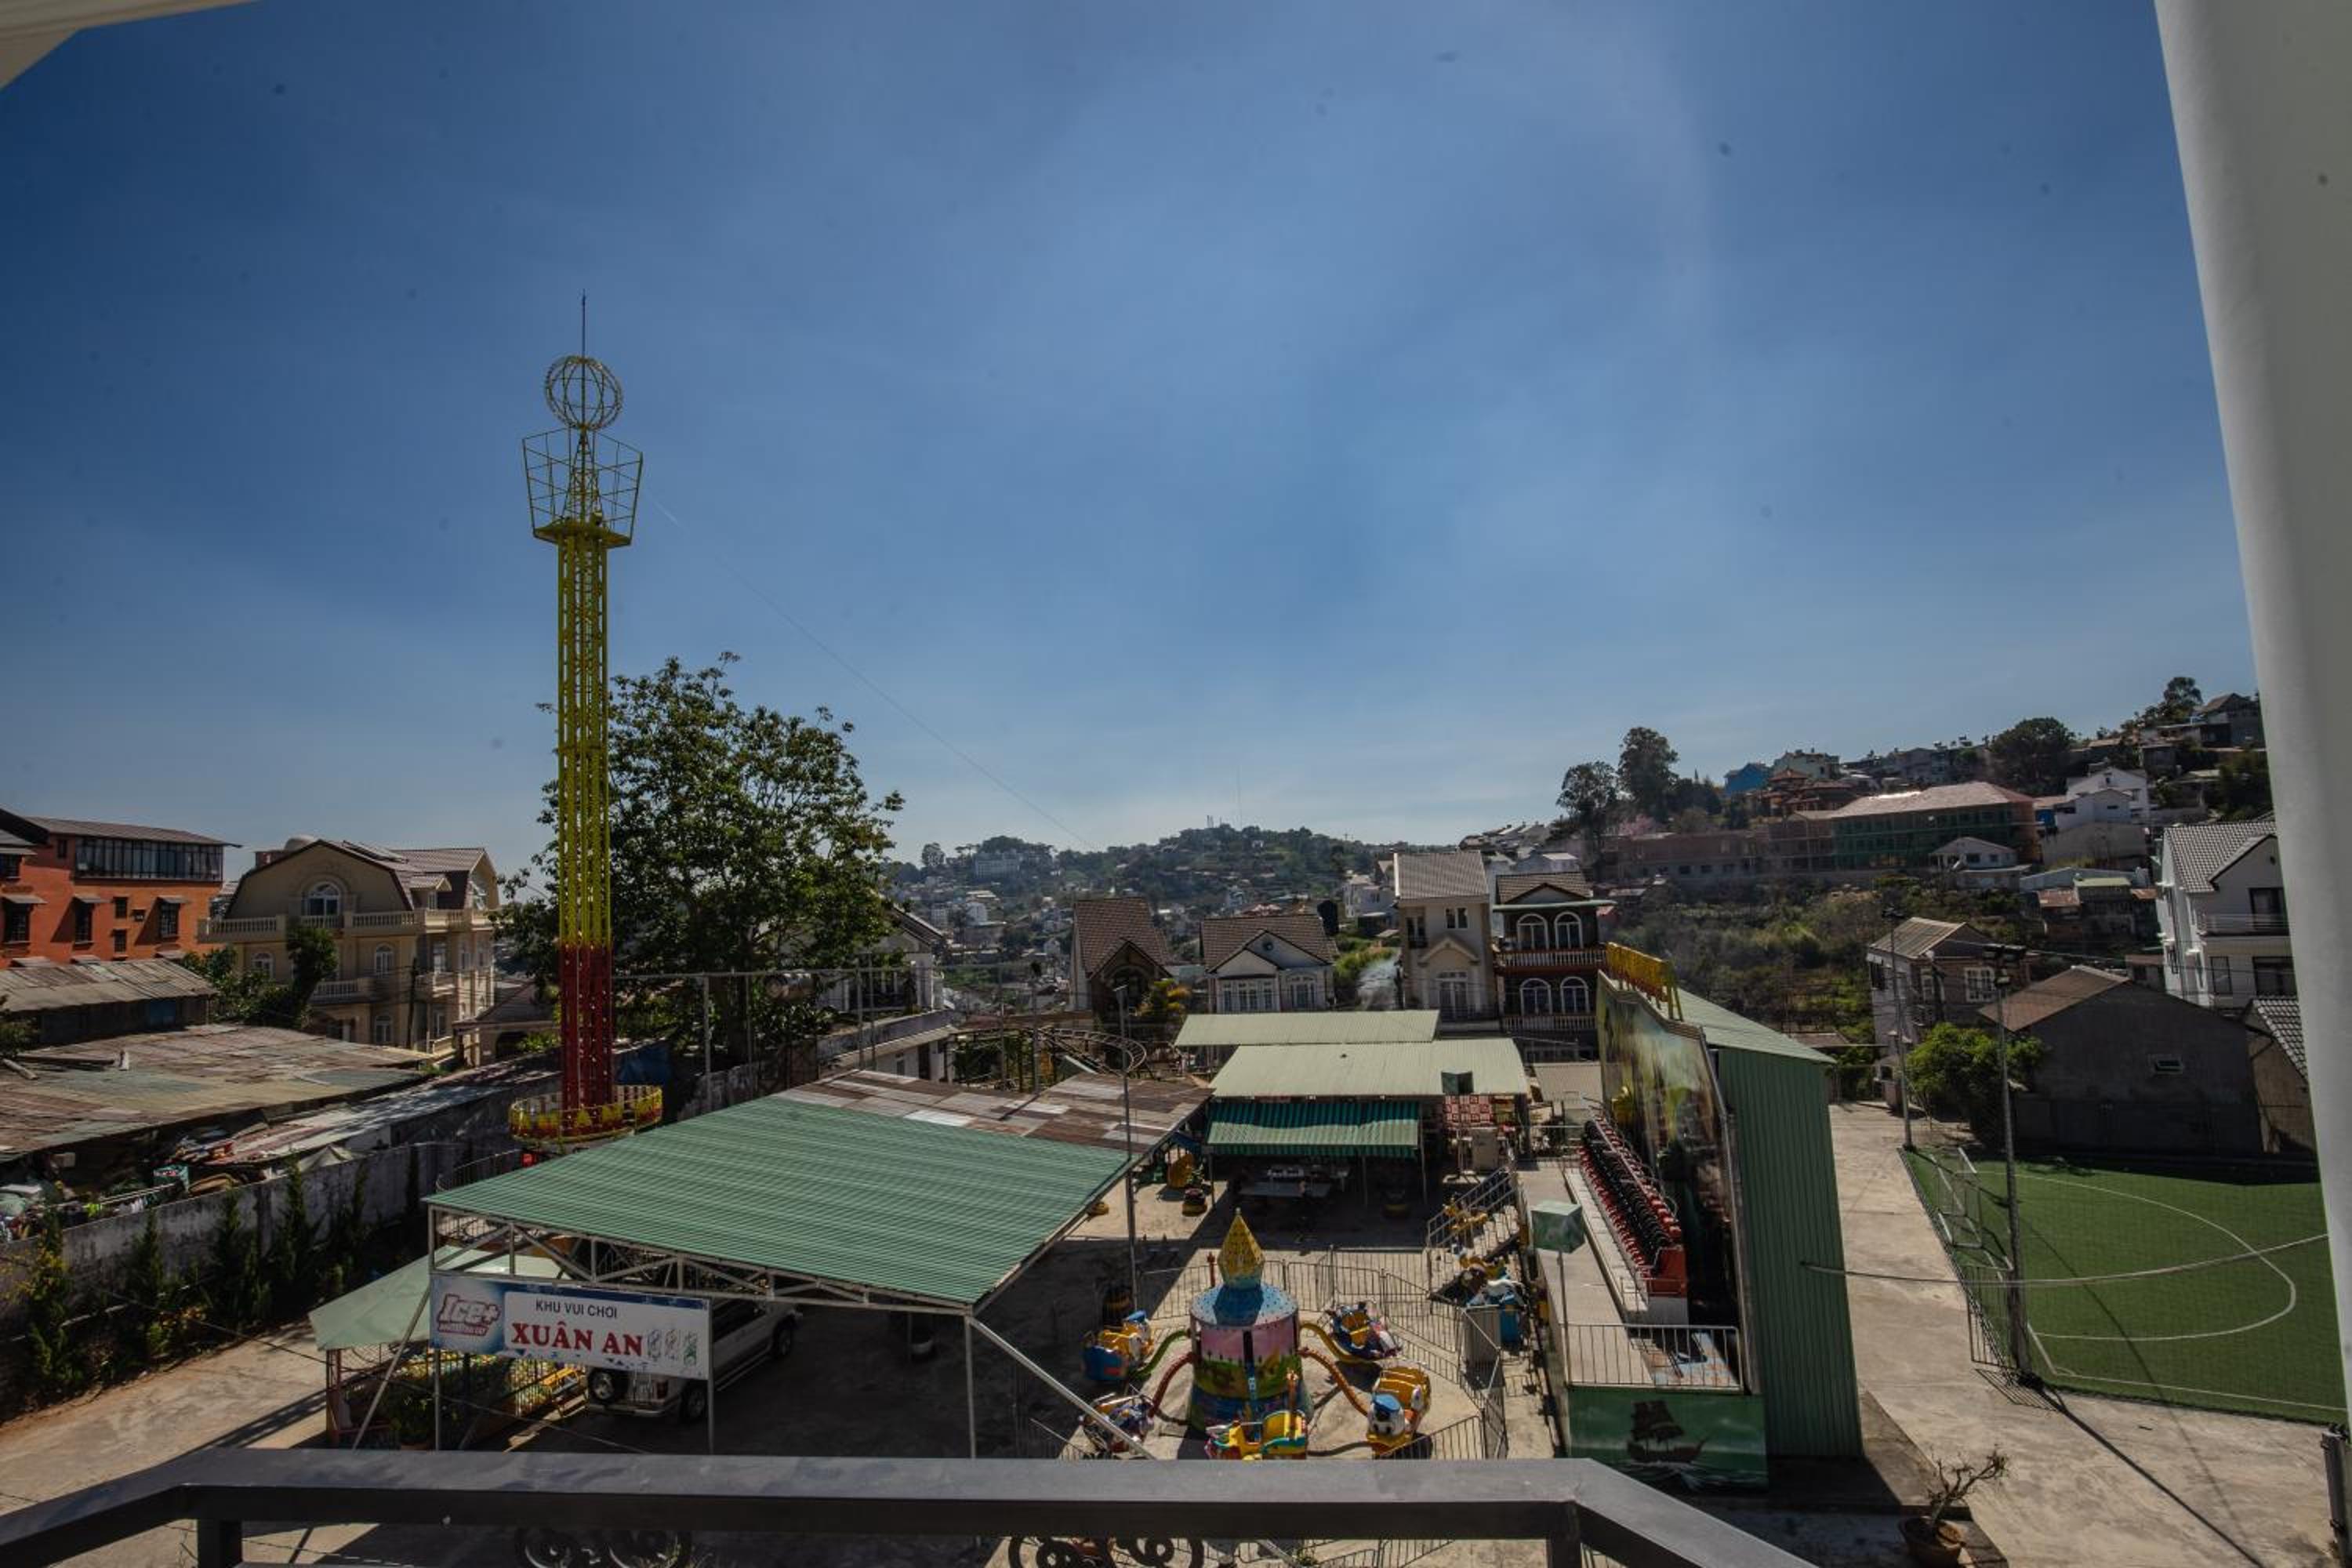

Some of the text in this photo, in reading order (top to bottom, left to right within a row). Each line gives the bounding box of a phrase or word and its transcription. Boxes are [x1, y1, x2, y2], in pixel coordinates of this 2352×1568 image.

[535, 1299, 561, 1313] KHU
[564, 1303, 584, 1315] VUI
[511, 1322, 593, 1352] XUÂN
[602, 1331, 644, 1356] AN
